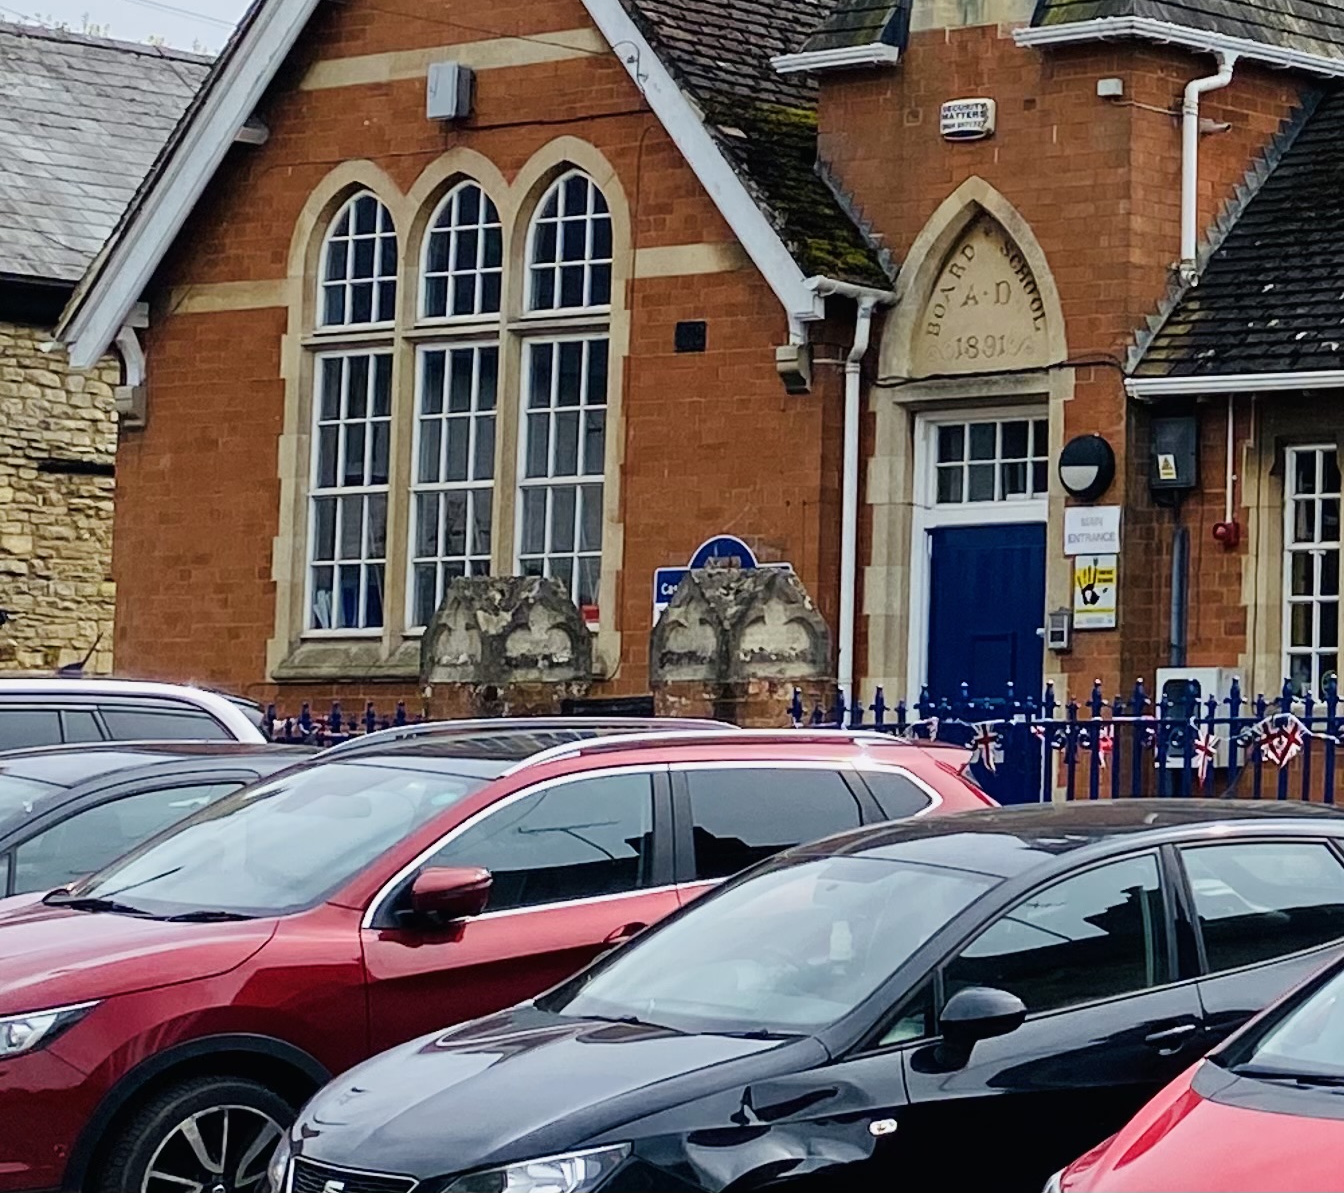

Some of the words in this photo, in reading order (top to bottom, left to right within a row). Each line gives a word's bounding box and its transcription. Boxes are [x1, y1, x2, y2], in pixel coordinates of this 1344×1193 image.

[926, 243, 976, 337] BOARD
[1000, 240, 1046, 332] SCHOOL
[955, 334, 1006, 360] 1891
